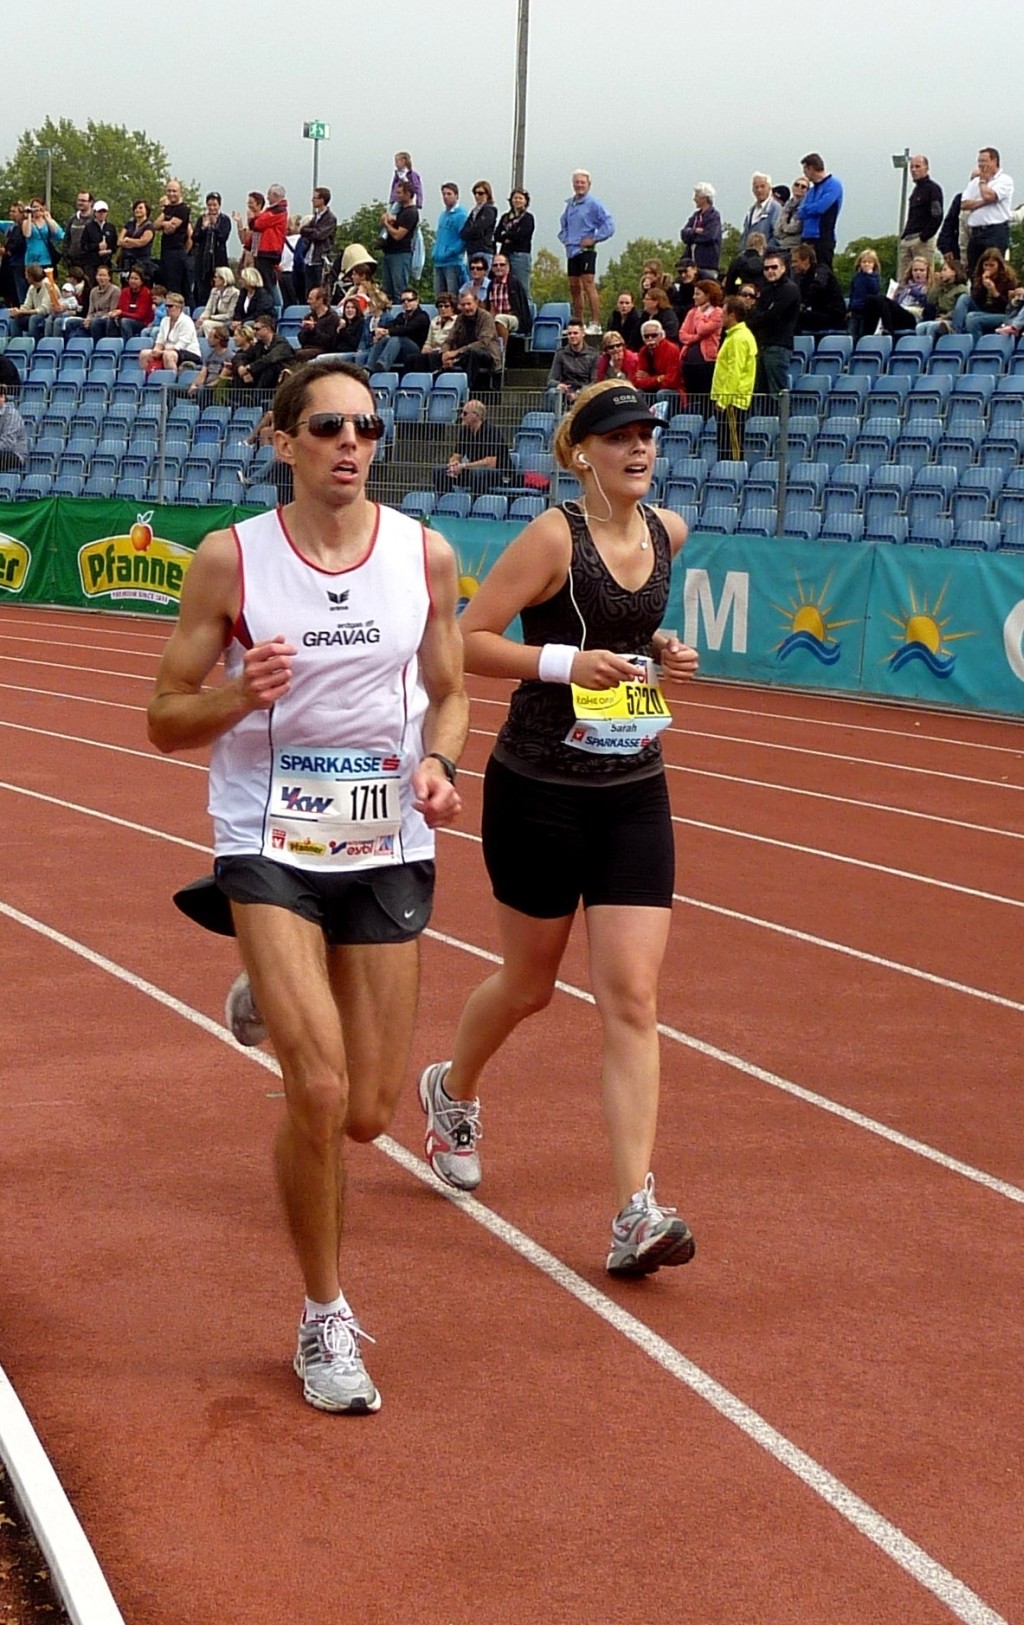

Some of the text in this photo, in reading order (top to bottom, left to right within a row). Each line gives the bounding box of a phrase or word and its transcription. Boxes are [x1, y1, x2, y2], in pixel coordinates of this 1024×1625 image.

[302, 628, 380, 647] GRAVAG
[625, 685, 664, 715] 5220
[610, 724, 637, 733] Sarah
[585, 736, 640, 748] SPARKASSE
[280, 754, 381, 773] SPARKASSE
[350, 784, 388, 821] 1711
